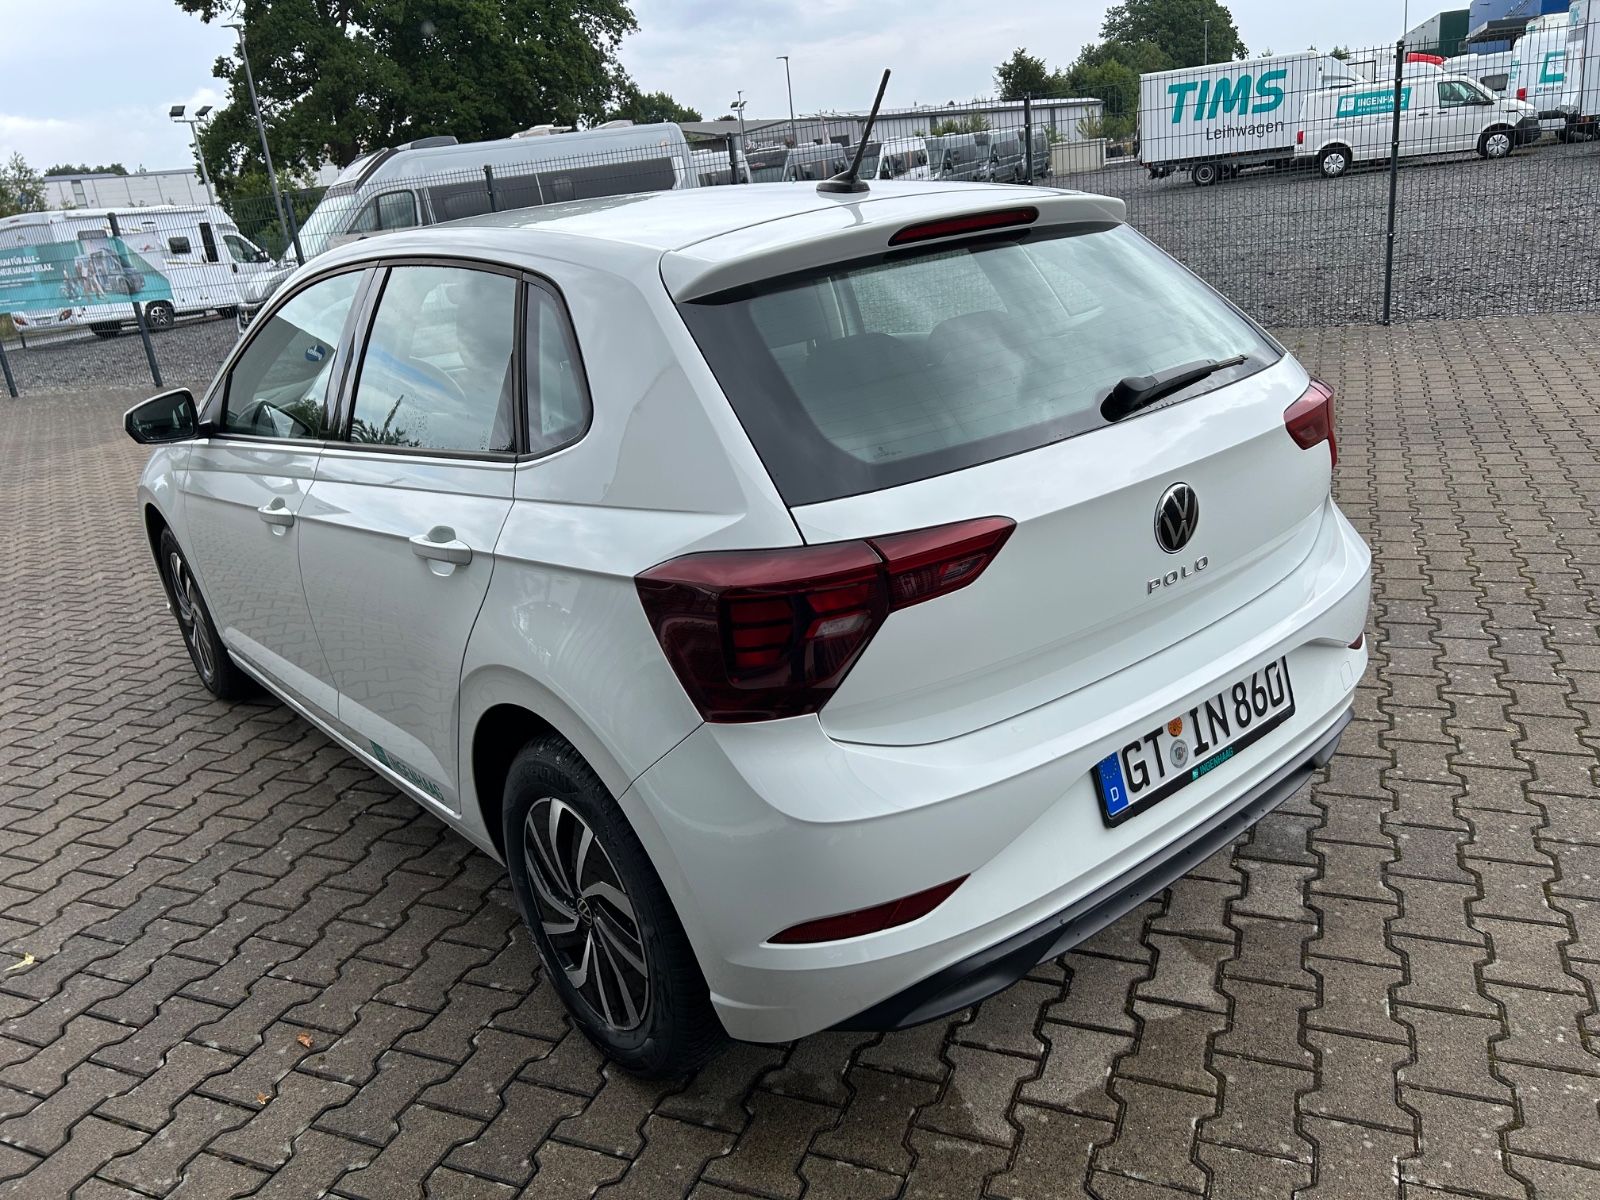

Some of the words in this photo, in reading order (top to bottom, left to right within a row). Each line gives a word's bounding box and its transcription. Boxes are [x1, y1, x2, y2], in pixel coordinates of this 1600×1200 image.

[1167, 69, 1287, 124] TIMS
[1357, 93, 1406, 107] INGENHAG
[1206, 121, 1285, 141] Leihwagen
[1147, 555, 1209, 595] POLO
[1121, 727, 1165, 793] GT
[1189, 692, 1231, 758] IN
[1231, 661, 1285, 729] 860
[1110, 786, 1121, 803] D
